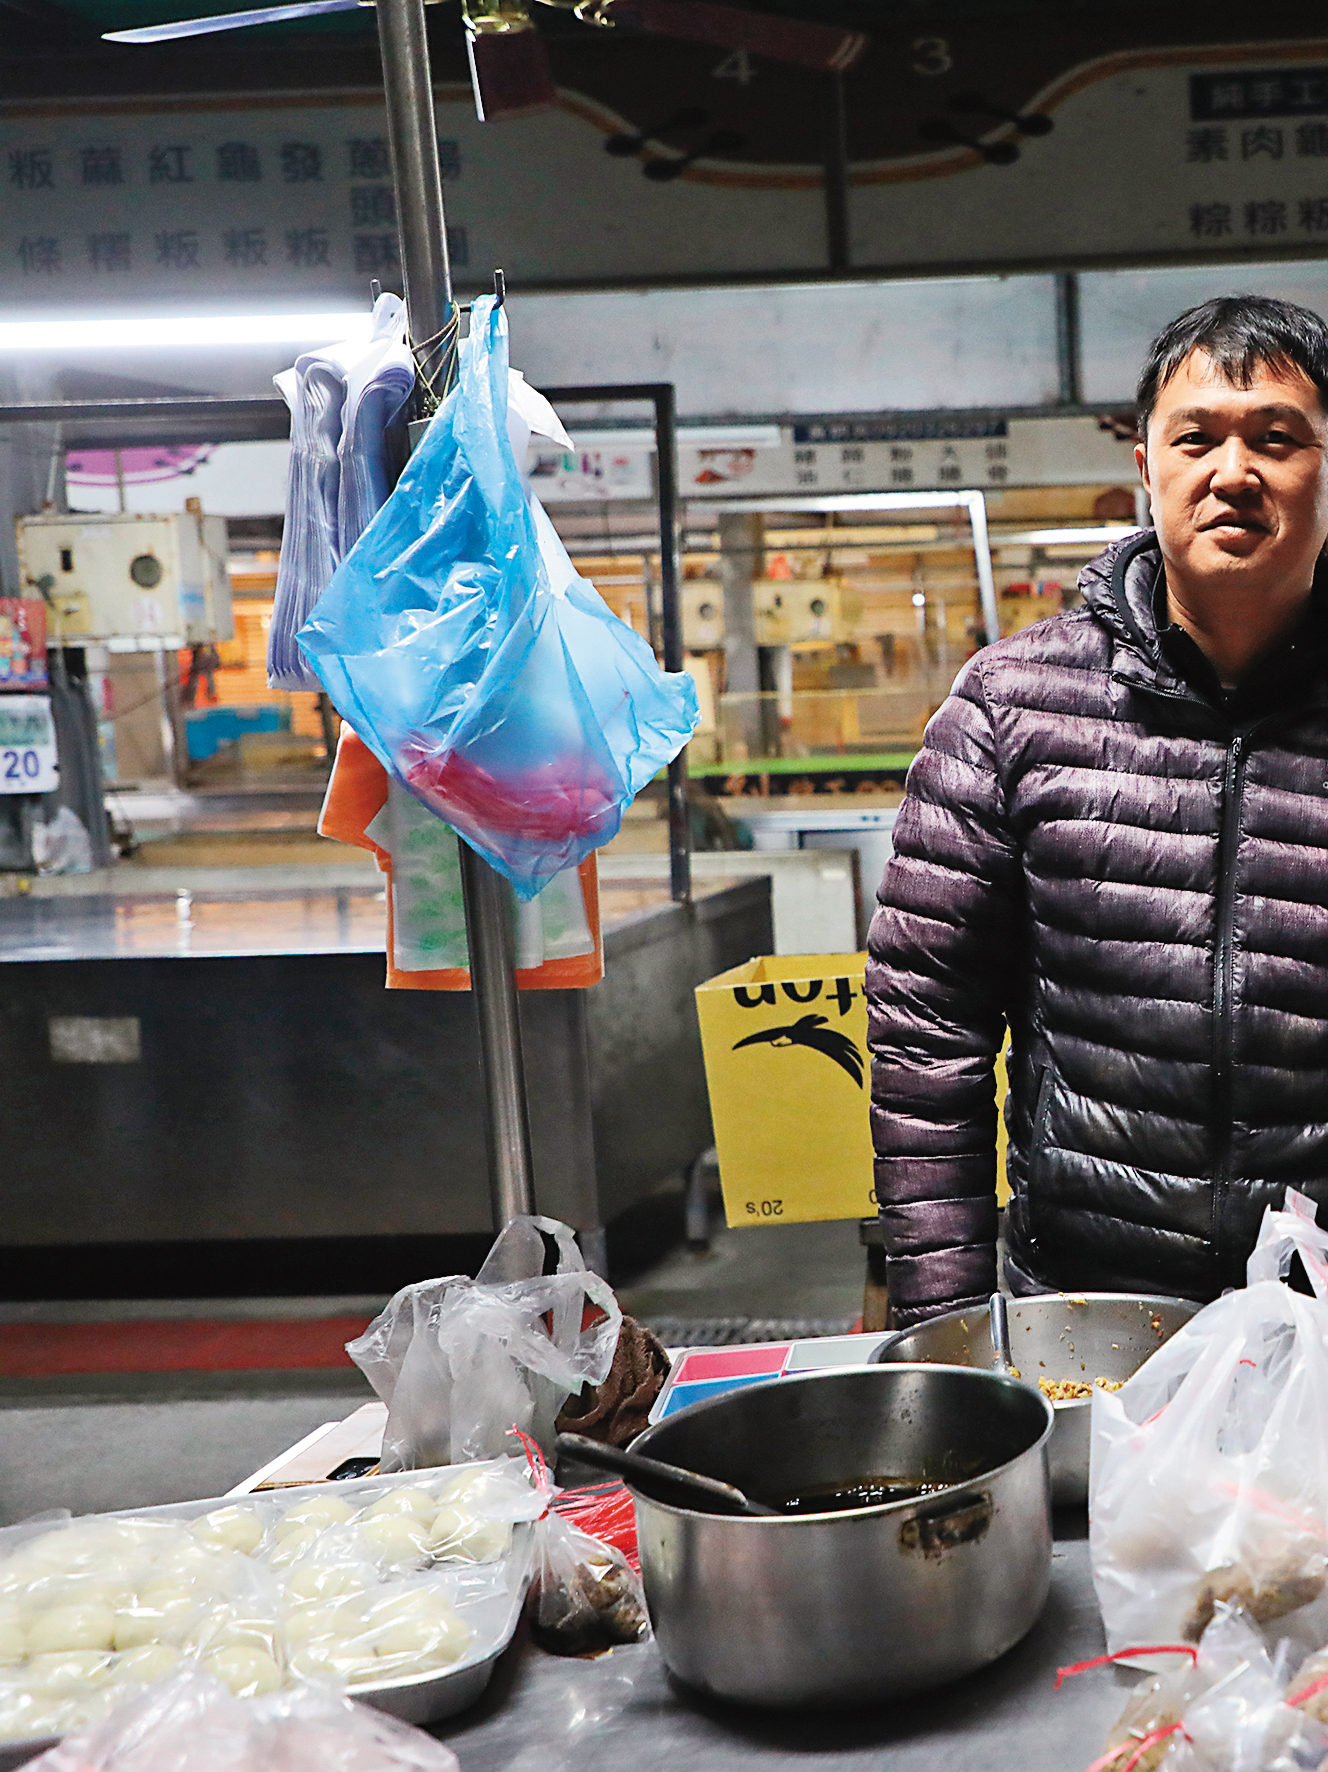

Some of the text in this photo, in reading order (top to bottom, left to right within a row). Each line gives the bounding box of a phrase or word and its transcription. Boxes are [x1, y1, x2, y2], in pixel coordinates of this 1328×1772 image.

[711, 48, 758, 86] 4
[912, 37, 954, 76] 3
[4, 751, 39, 778] 20
[746, 1200, 784, 1217] 20's
